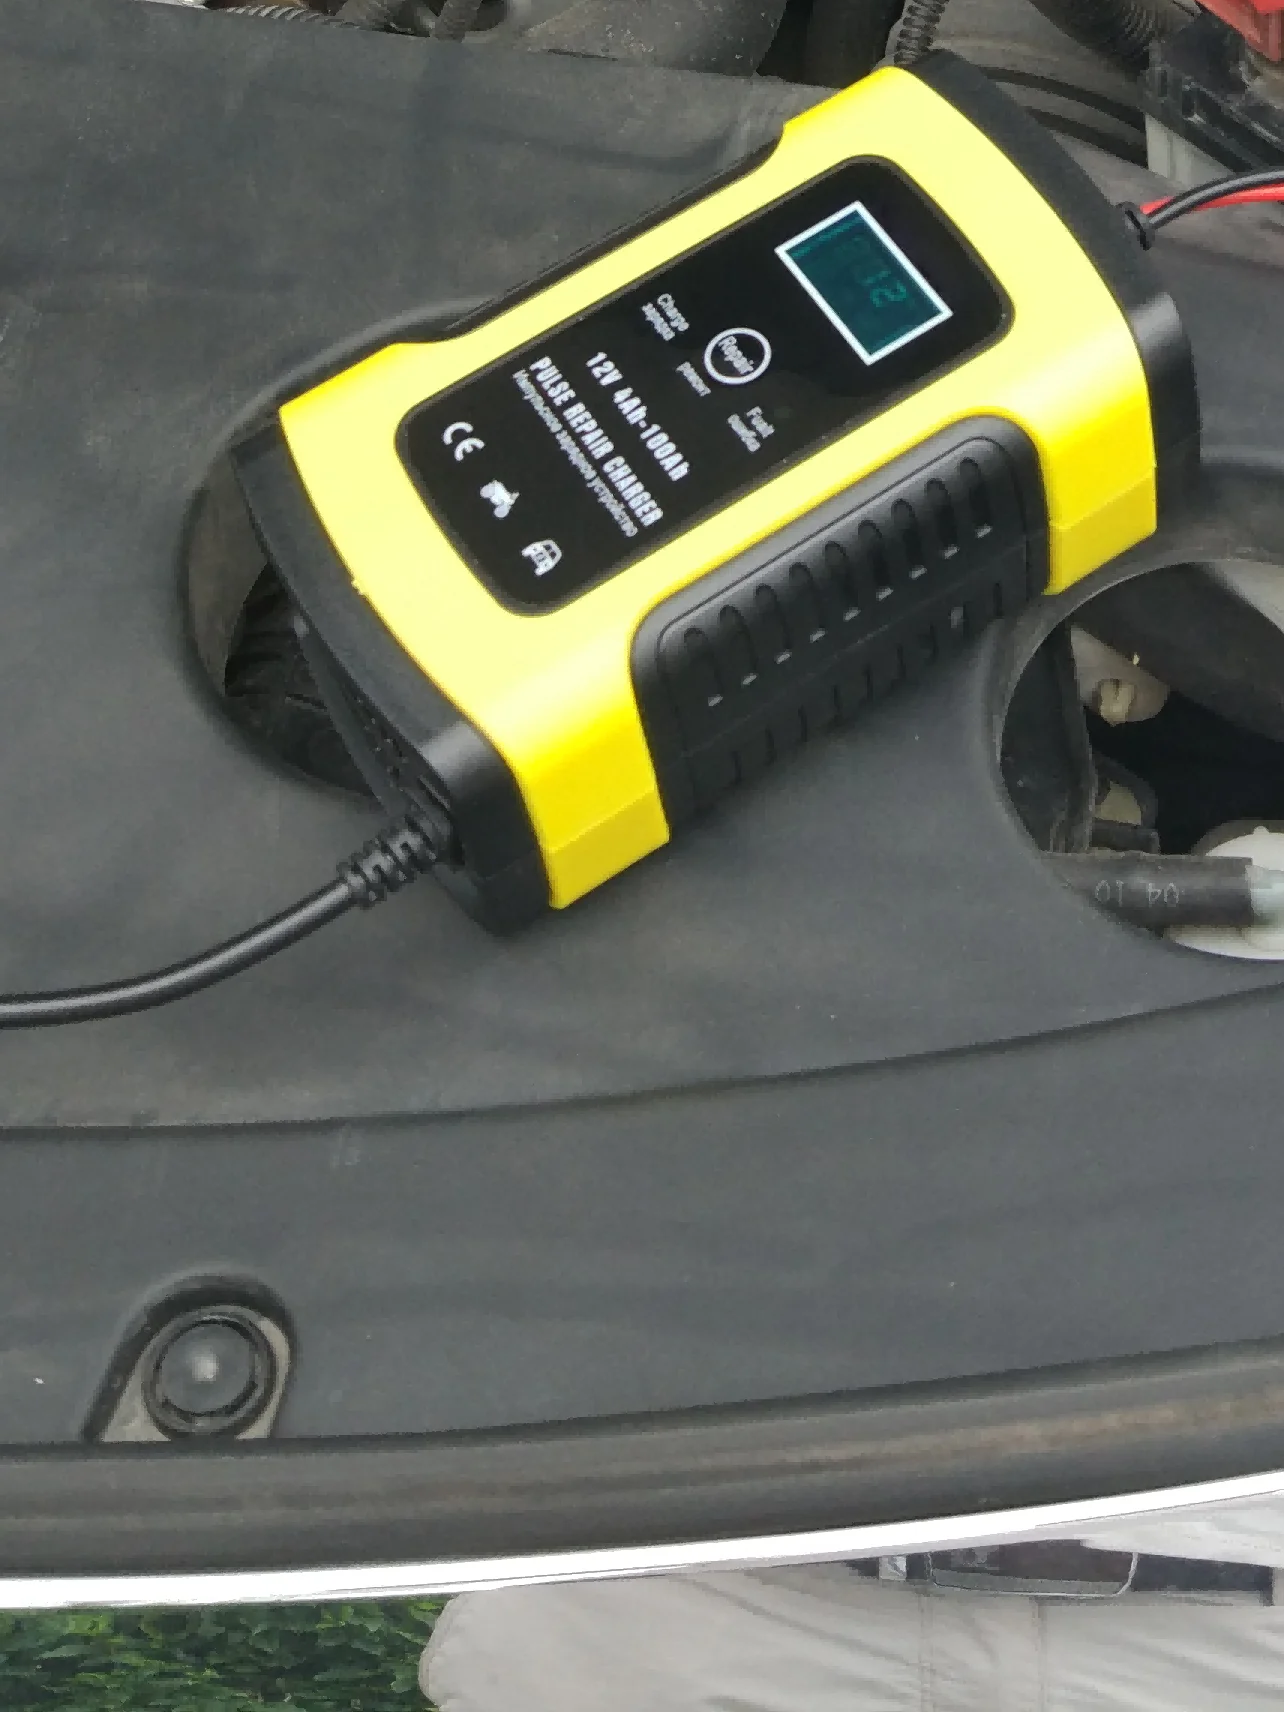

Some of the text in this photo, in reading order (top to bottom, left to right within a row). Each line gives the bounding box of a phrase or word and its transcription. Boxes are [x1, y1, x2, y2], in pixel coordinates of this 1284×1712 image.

[657, 294, 689, 331] Charge
[717, 335, 756, 376] Repair
[529, 356, 663, 527] PULSE REPAIR CHARGER
[586, 352, 689, 481] 12V 4Ah-100Ah
